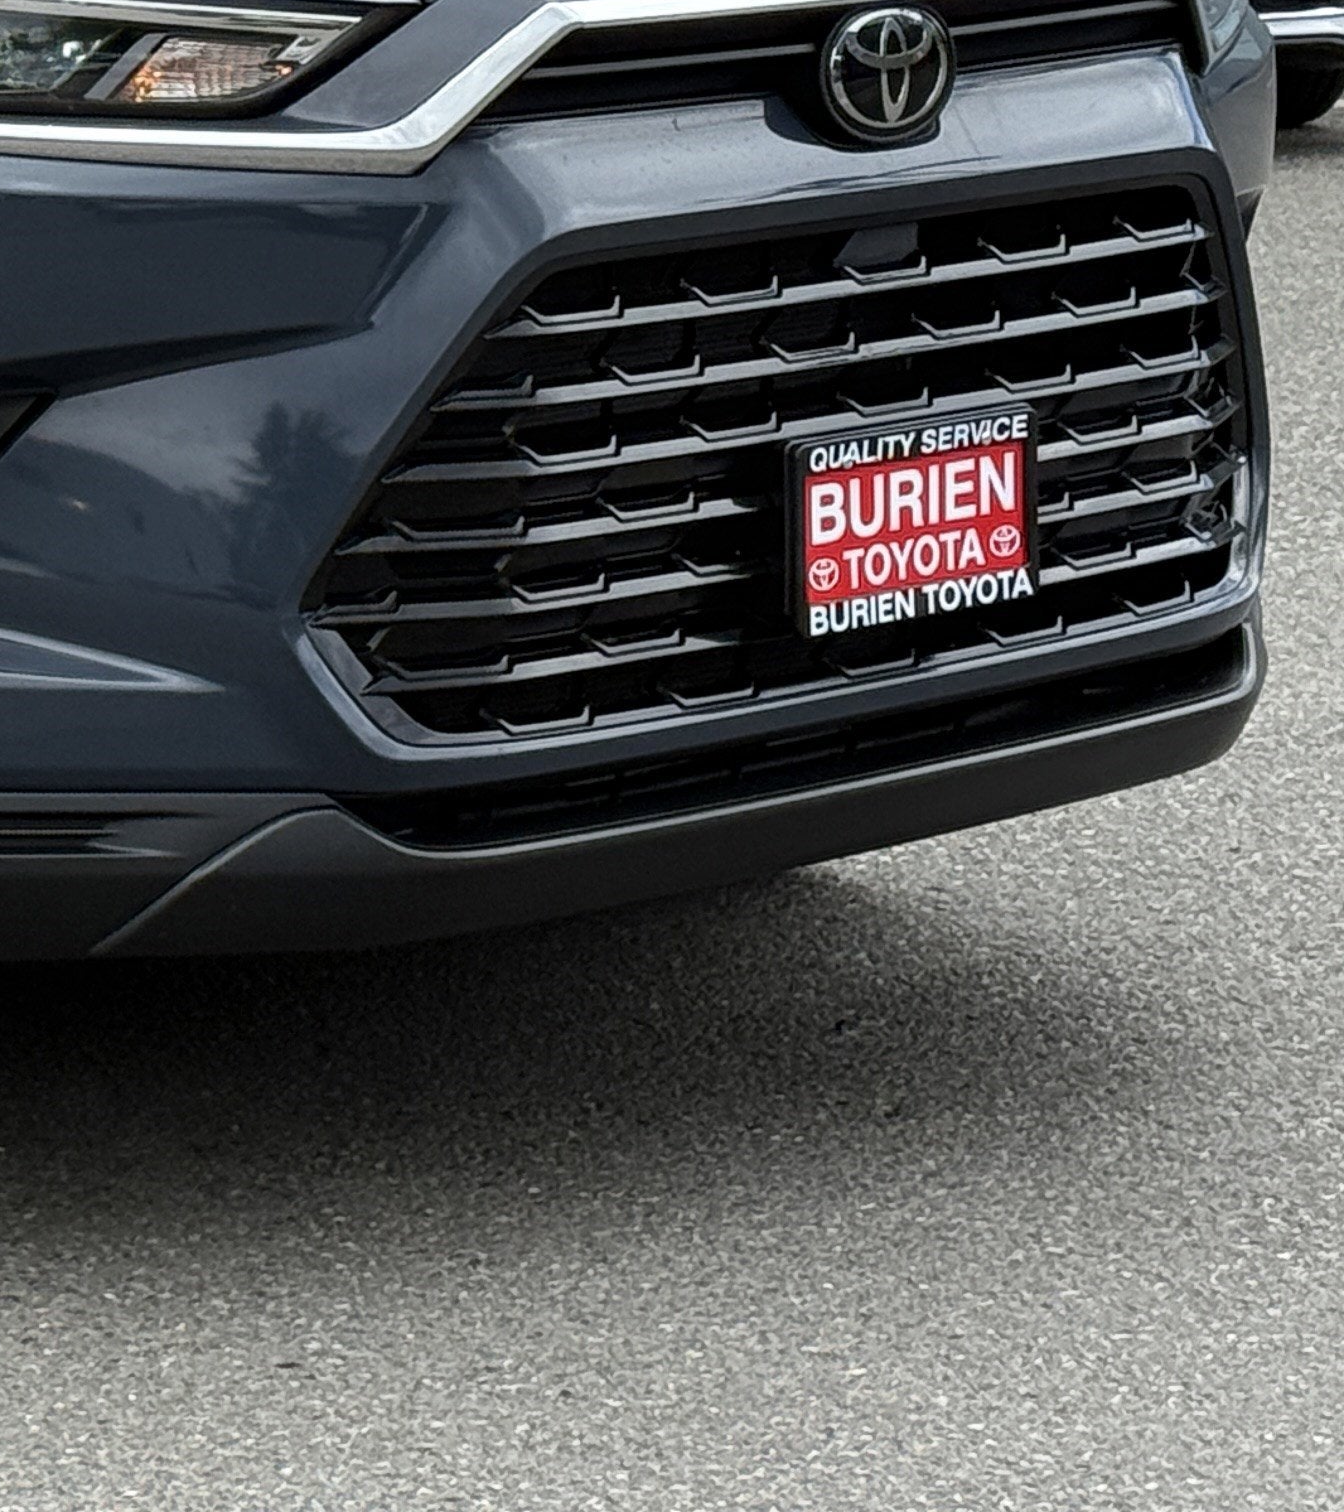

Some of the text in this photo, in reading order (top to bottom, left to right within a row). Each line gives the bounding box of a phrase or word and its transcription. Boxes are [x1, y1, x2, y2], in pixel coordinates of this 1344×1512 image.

[809, 414, 1029, 473] QUALITY SERVICE
[810, 451, 1016, 546] BURIEN
[842, 528, 986, 590] TOYOTA
[810, 567, 1034, 636] BURIEN TOYOTA
